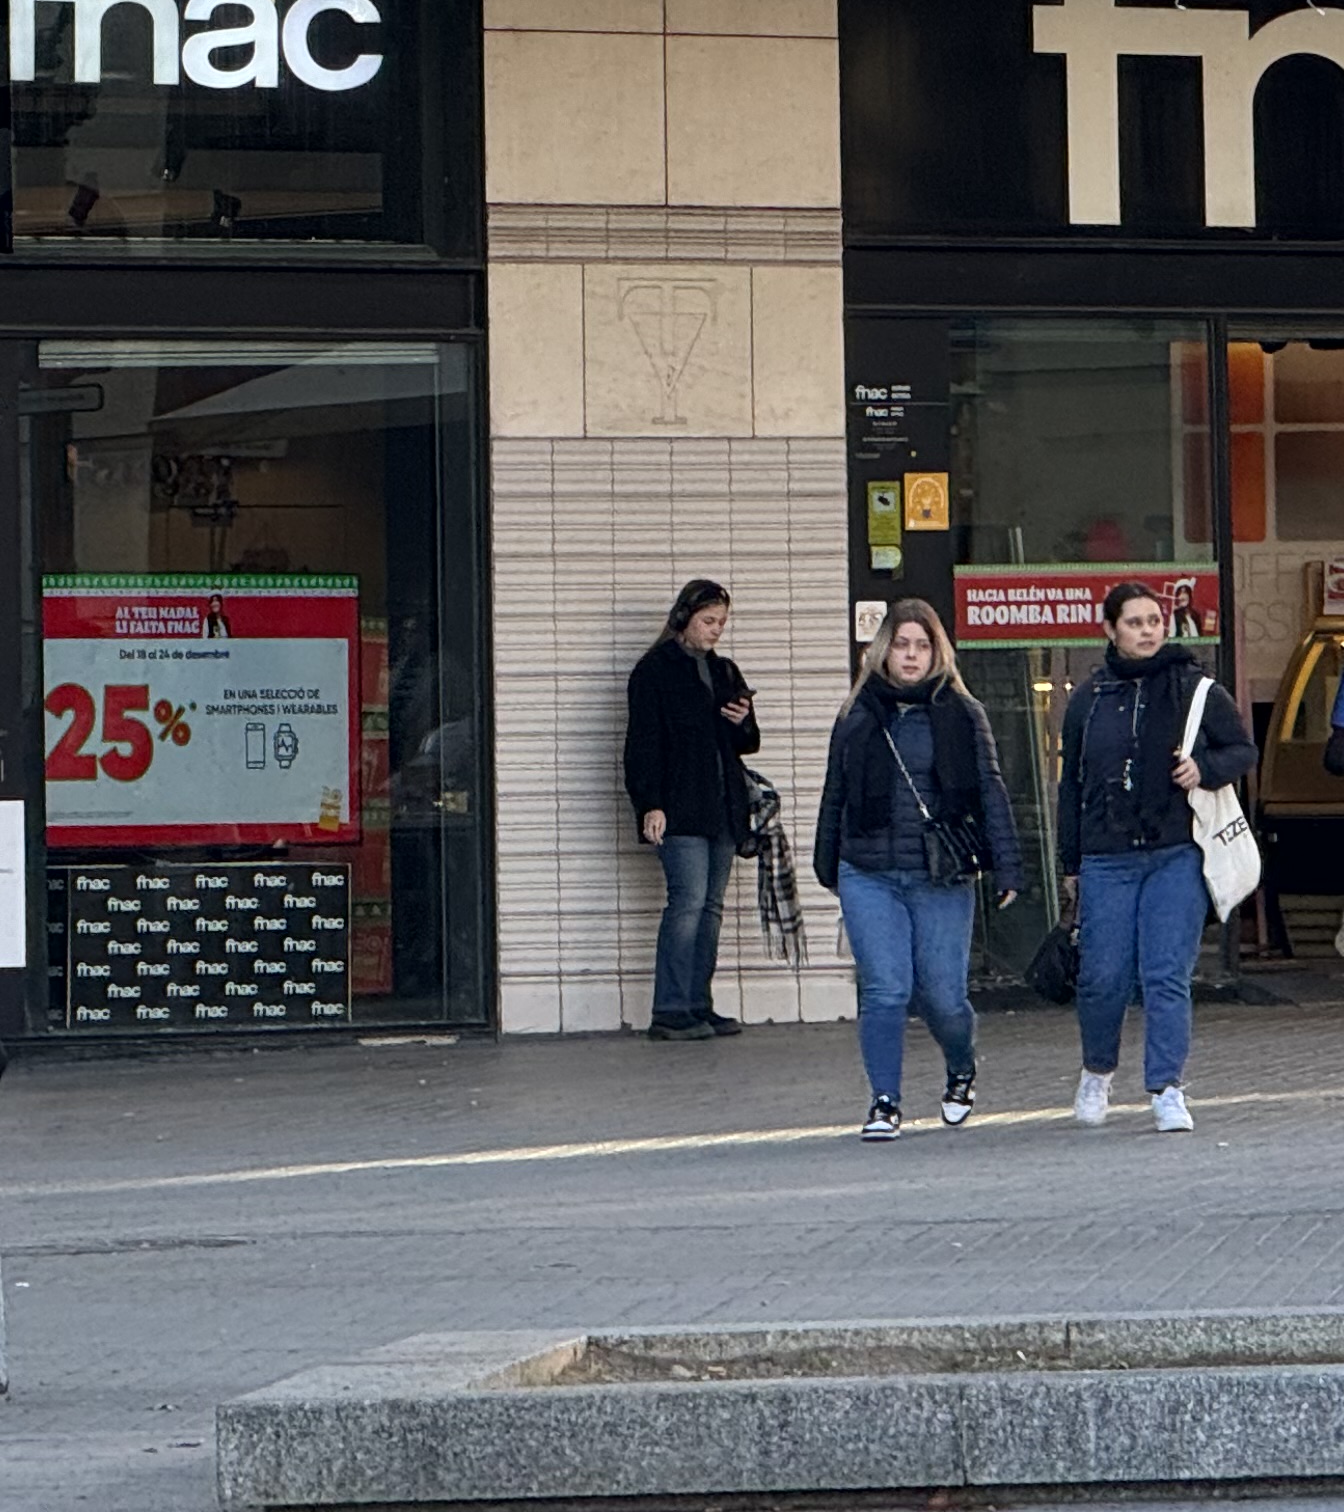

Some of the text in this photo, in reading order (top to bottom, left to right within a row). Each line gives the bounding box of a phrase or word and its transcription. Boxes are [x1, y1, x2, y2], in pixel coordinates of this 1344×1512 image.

[855, 385, 887, 400] fnac
[966, 585, 1092, 602] HACIA BELÉN VA UNA
[115, 606, 199, 619] AL TEU NADAL
[967, 604, 1055, 625] ROOMBA
[1057, 603, 1092, 624] RIN
[129, 620, 166, 634] FALTA
[167, 620, 200, 634] FNAC
[119, 649, 135, 659] Del
[148, 649, 157, 659] al
[158, 649, 170, 659] 24
[171, 649, 184, 659] de
[223, 689, 236, 700] EN
[238, 689, 258, 700] UNA
[307, 689, 320, 699] DE
[205, 704, 276, 715] SMARTPHONES
[282, 704, 339, 715] WEARABLES
[77, 876, 109, 889] fnac
[137, 875, 169, 889] fnac
[196, 875, 228, 888] fnac
[254, 873, 286, 886] fnac
[312, 873, 344, 885] fnac
[108, 894, 316, 911] fnac fnac fnac fnac
[77, 919, 110, 933] fnac
[137, 918, 169, 931] fnac
[196, 918, 228, 931] fnac
[254, 916, 286, 929] fnac
[312, 915, 344, 929] fnac
[108, 937, 315, 954] fnac fnac fnac fnac
[77, 963, 110, 976] fnac
[137, 962, 169, 975] fnac
[196, 961, 228, 974] fnac
[254, 960, 286, 973] fnac
[312, 959, 343, 971] fnac
[108, 981, 315, 997] fnac fnac fnac fnac
[77, 1007, 110, 1020] fnac
[137, 1005, 169, 1018] fnac
[196, 1004, 227, 1017] fnac
[253, 1003, 285, 1016] fnac
[312, 1001, 343, 1014] fnac
